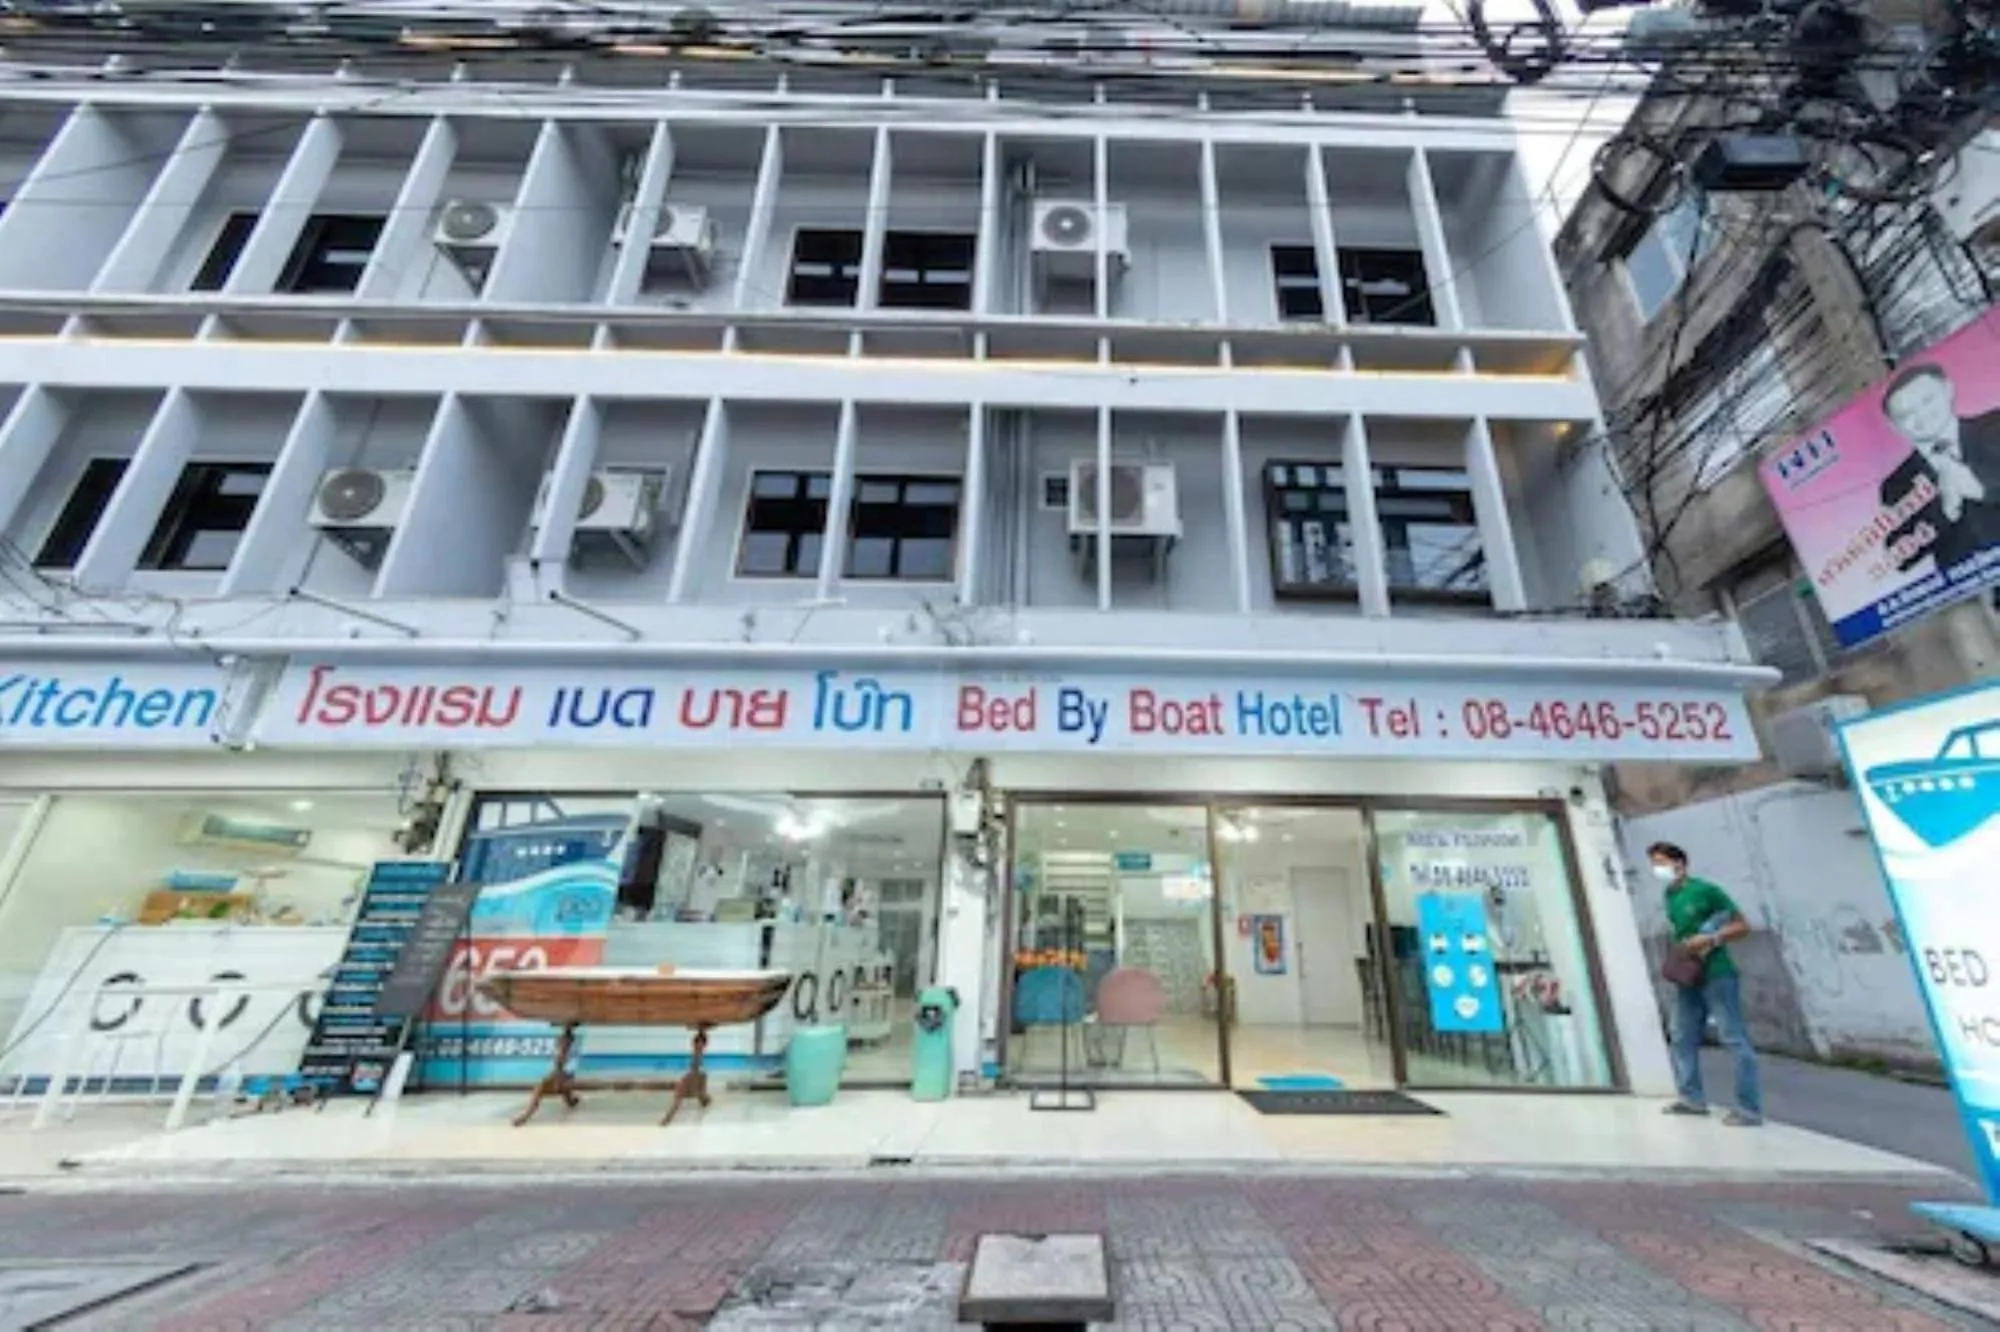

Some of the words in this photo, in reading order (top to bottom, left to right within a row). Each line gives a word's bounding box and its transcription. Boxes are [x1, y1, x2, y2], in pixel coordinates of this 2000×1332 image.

[295, 665, 521, 728] โรงแรม
[549, 687, 655, 729] เบด
[680, 689, 788, 729] บาย
[957, 686, 1036, 732] Bed
[1057, 689, 1108, 744] By
[1129, 690, 1222, 735] Boat
[1237, 691, 1341, 736] Hotel
[1358, 699, 1420, 738] Tel
[1464, 701, 1732, 740] 08-4646-5252
[1925, 948, 1988, 986] BED
